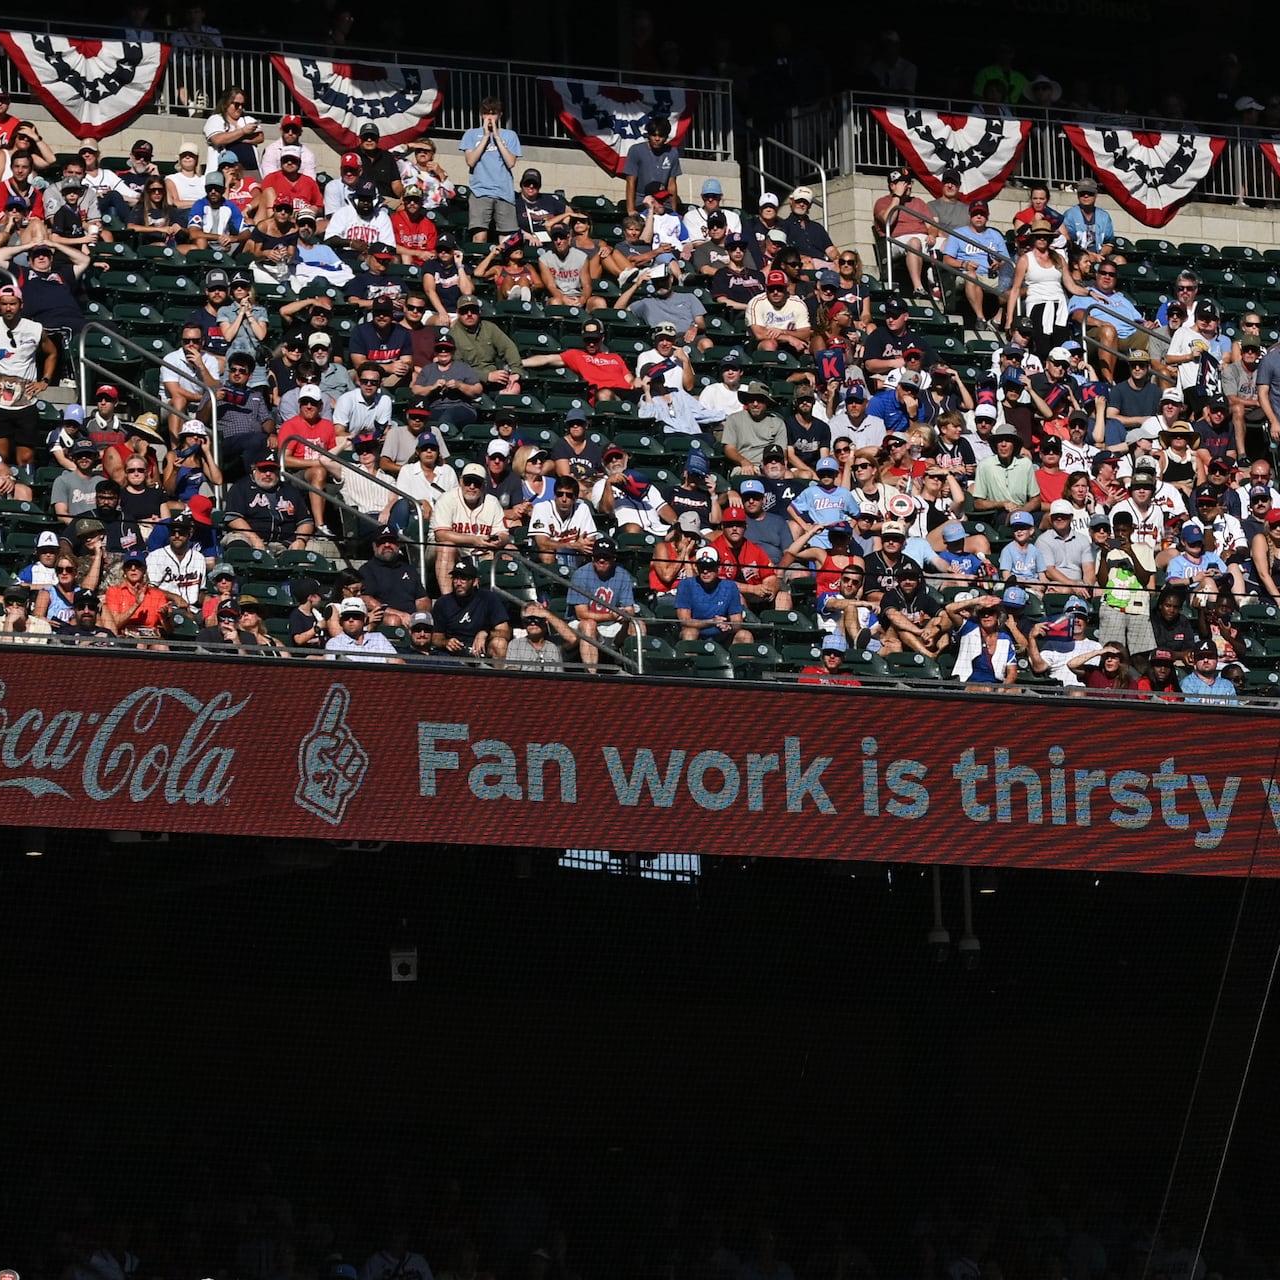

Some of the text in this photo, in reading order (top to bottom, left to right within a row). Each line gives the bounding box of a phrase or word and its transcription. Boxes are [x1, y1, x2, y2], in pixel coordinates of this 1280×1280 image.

[823, 357, 840, 378] K
[164, 567, 198, 584] Braves
[417, 721, 577, 802] Fan
[602, 736, 840, 815] work
[861, 736, 929, 820] is
[953, 744, 1239, 850] thirsty
